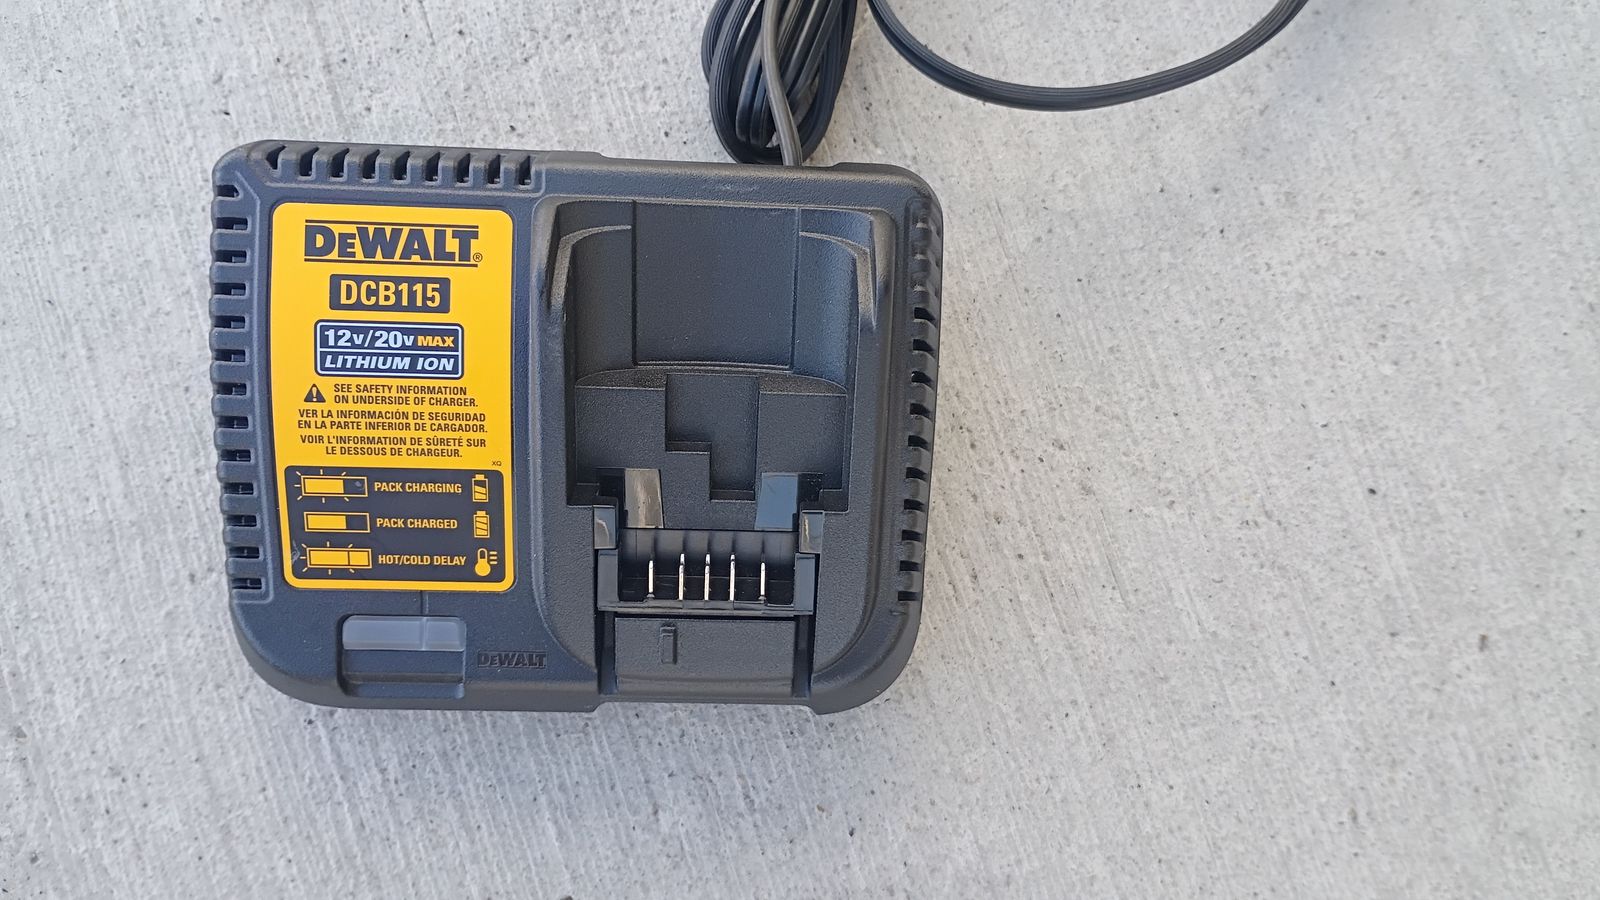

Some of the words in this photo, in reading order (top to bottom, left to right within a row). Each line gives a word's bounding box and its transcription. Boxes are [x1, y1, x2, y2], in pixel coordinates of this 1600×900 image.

[340, 279, 441, 308] DCB115
[417, 336, 455, 347] MAX
[324, 355, 410, 370] LITHIUM
[416, 357, 455, 371] ION
[334, 384, 353, 393] SEE
[355, 384, 393, 394] SAFETY
[396, 385, 467, 396] INFORMATION
[334, 395, 349, 404] ON
[352, 395, 410, 406] UNDERSIDE
[414, 397, 426, 406] OF
[428, 397, 479, 407] CHARGER.
[298, 409, 318, 418] VER
[321, 409, 333, 419] LA
[336, 408, 409, 421] INFORMACIÓN
[412, 412, 425, 421] DE
[428, 412, 486, 422] SEGURIDAD
[298, 420, 312, 429] EN
[314, 420, 327, 430] LA
[330, 420, 362, 430] PARTE
[365, 422, 410, 431] INFERIOR
[414, 423, 427, 432] DE
[430, 423, 488, 433] CARGADOR.
[300, 434, 325, 444] VOIR
[327, 435, 407, 446] L'INFORMATION
[410, 437, 423, 446] DE
[425, 434, 463, 447] SÛRETÉ
[466, 438, 486, 447] SUR
[325, 446, 337, 455] LE
[340, 446, 387, 456] DESSOUS
[390, 447, 403, 456] DE
[406, 448, 462, 458] CHARGEUR.
[374, 482, 404, 492] PACK
[405, 482, 462, 493] CHARGING
[376, 518, 405, 528] PACK
[407, 519, 458, 529] CHARGED
[378, 554, 431, 565] HOT/COLD
[433, 555, 466, 566] DELAY
